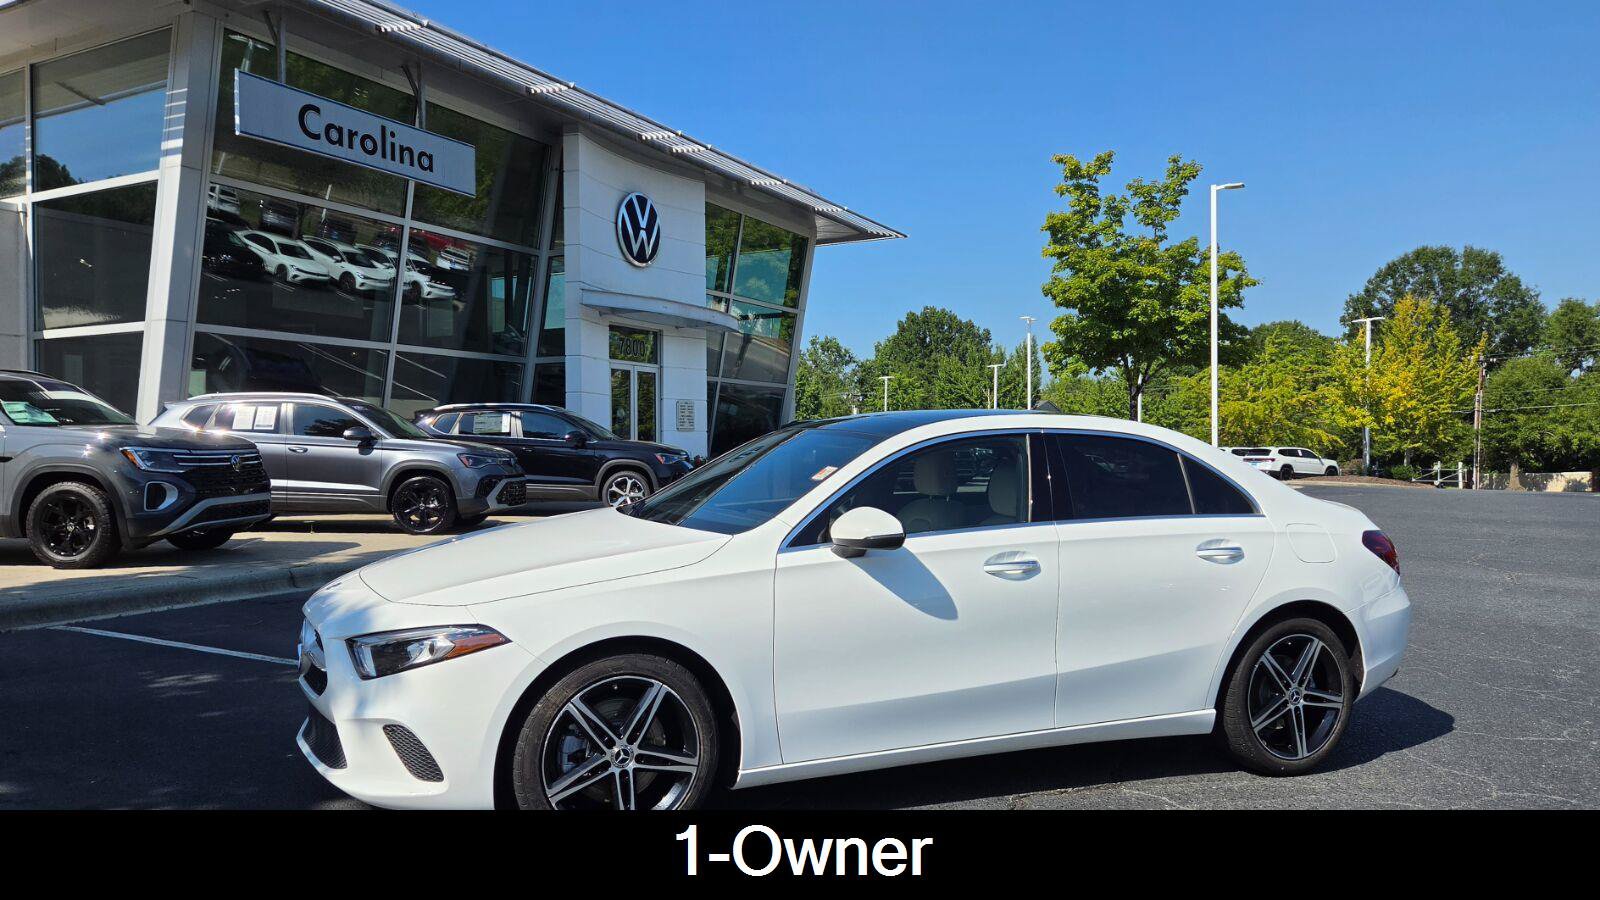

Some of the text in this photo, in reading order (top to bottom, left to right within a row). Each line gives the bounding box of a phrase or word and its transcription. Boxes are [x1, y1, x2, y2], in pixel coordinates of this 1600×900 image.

[298, 103, 434, 173] Carolina
[619, 192, 660, 261] VW
[617, 336, 646, 357] 7800
